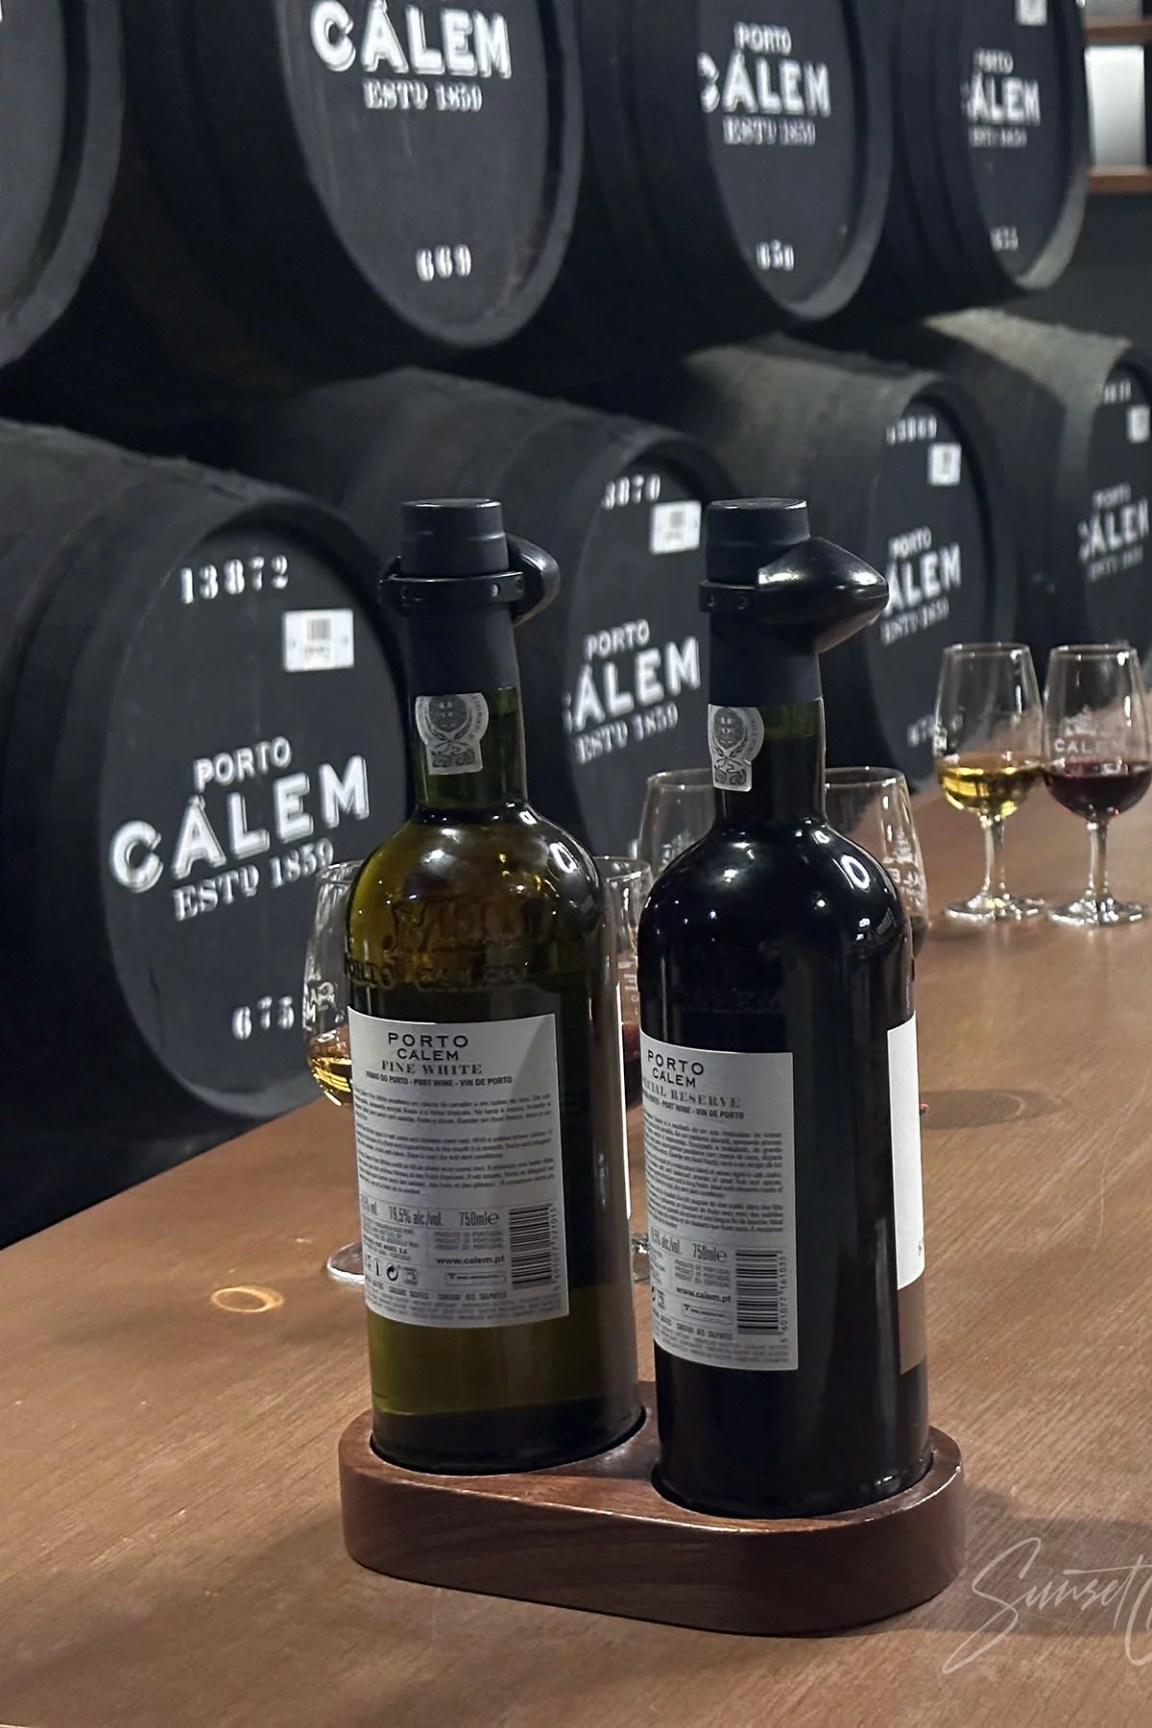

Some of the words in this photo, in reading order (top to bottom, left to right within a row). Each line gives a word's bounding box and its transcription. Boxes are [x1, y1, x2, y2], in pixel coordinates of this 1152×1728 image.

[734, 22, 792, 54] PORTO
[180, 555, 288, 604] 13872
[584, 619, 650, 661] PORTO
[194, 737, 291, 792] PORTO
[388, 1032, 468, 1048] PORTO
[397, 1048, 458, 1060] CALEM
[648, 1050, 704, 1076] PORTO
[382, 1060, 416, 1074] FINE
[422, 1064, 482, 1075] WHITE
[652, 1067, 696, 1088] CALEM
[488, 1076, 513, 1085] PORTO
[671, 1089, 741, 1108] RESERVE
[720, 1111, 744, 1119] PORTO
